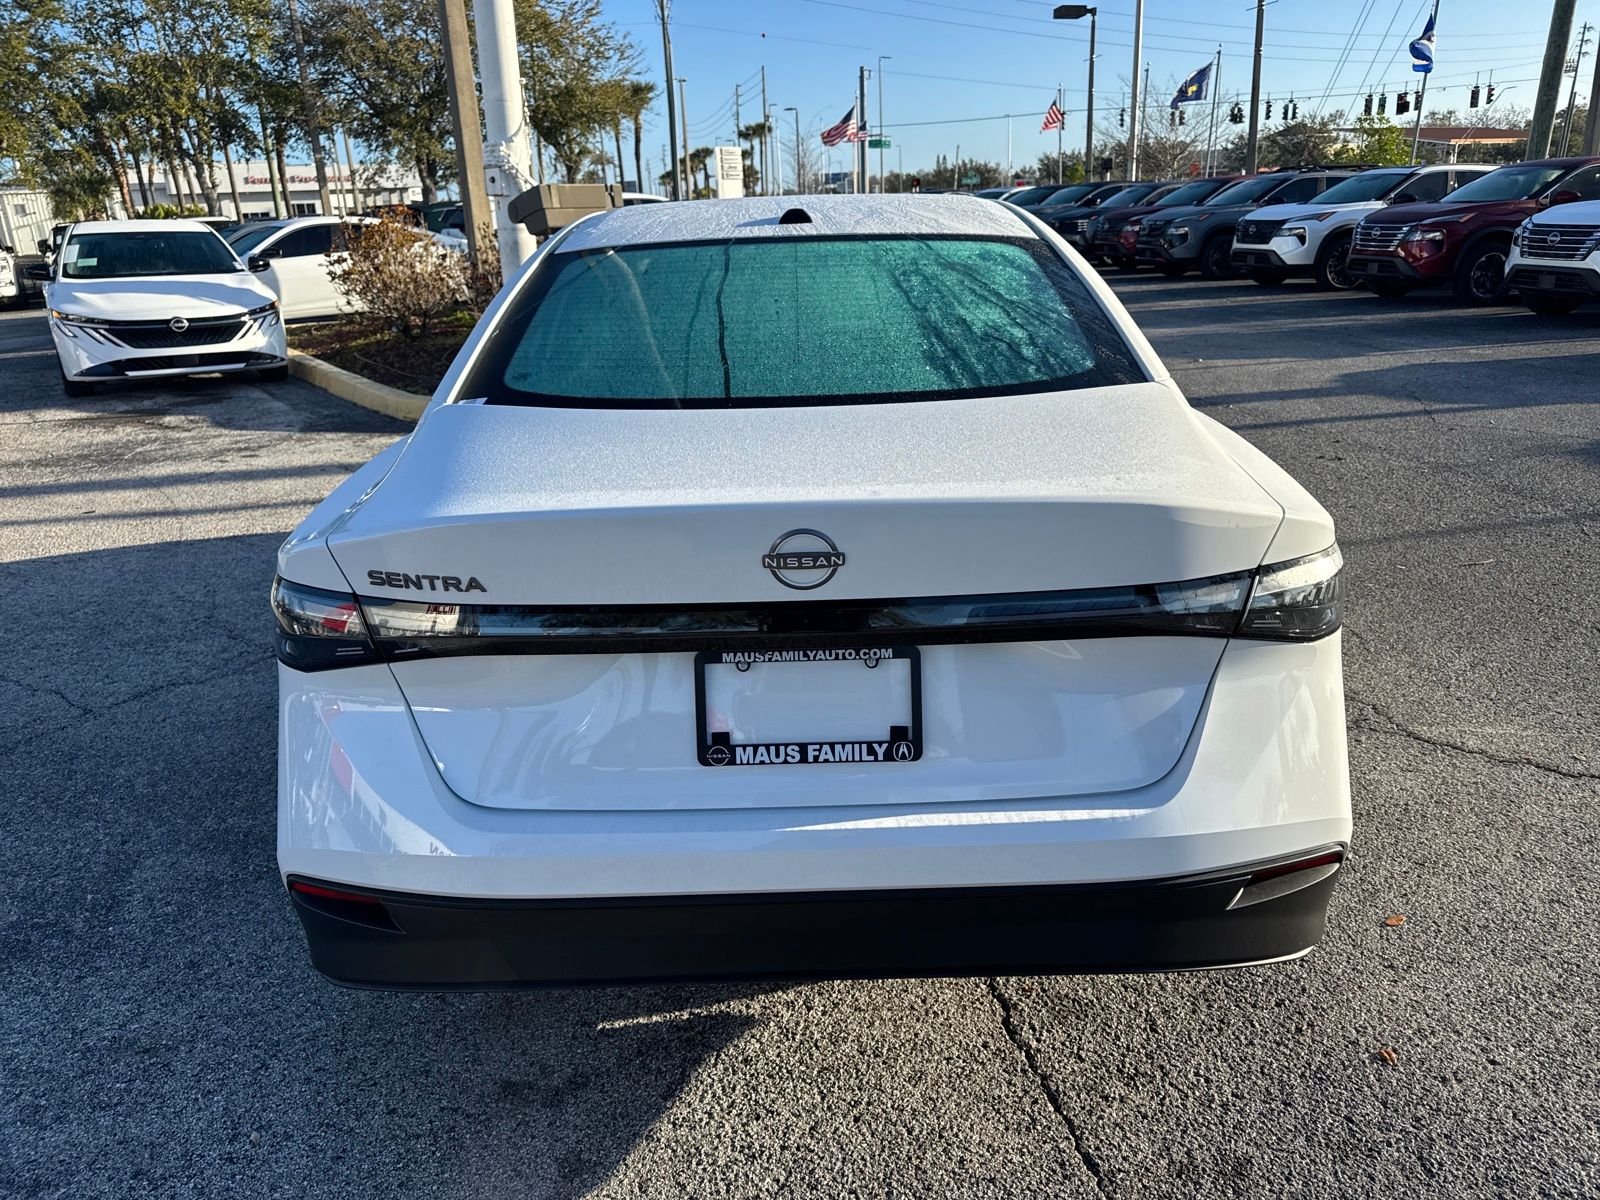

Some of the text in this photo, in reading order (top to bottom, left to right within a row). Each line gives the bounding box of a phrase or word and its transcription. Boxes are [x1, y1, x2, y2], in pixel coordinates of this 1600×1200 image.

[765, 555, 843, 567] NISSAN
[367, 569, 488, 593] SENTRA
[722, 648, 893, 663] MAUSFAMILYAUTO.COM
[735, 742, 889, 764] MAUS FAMILY
